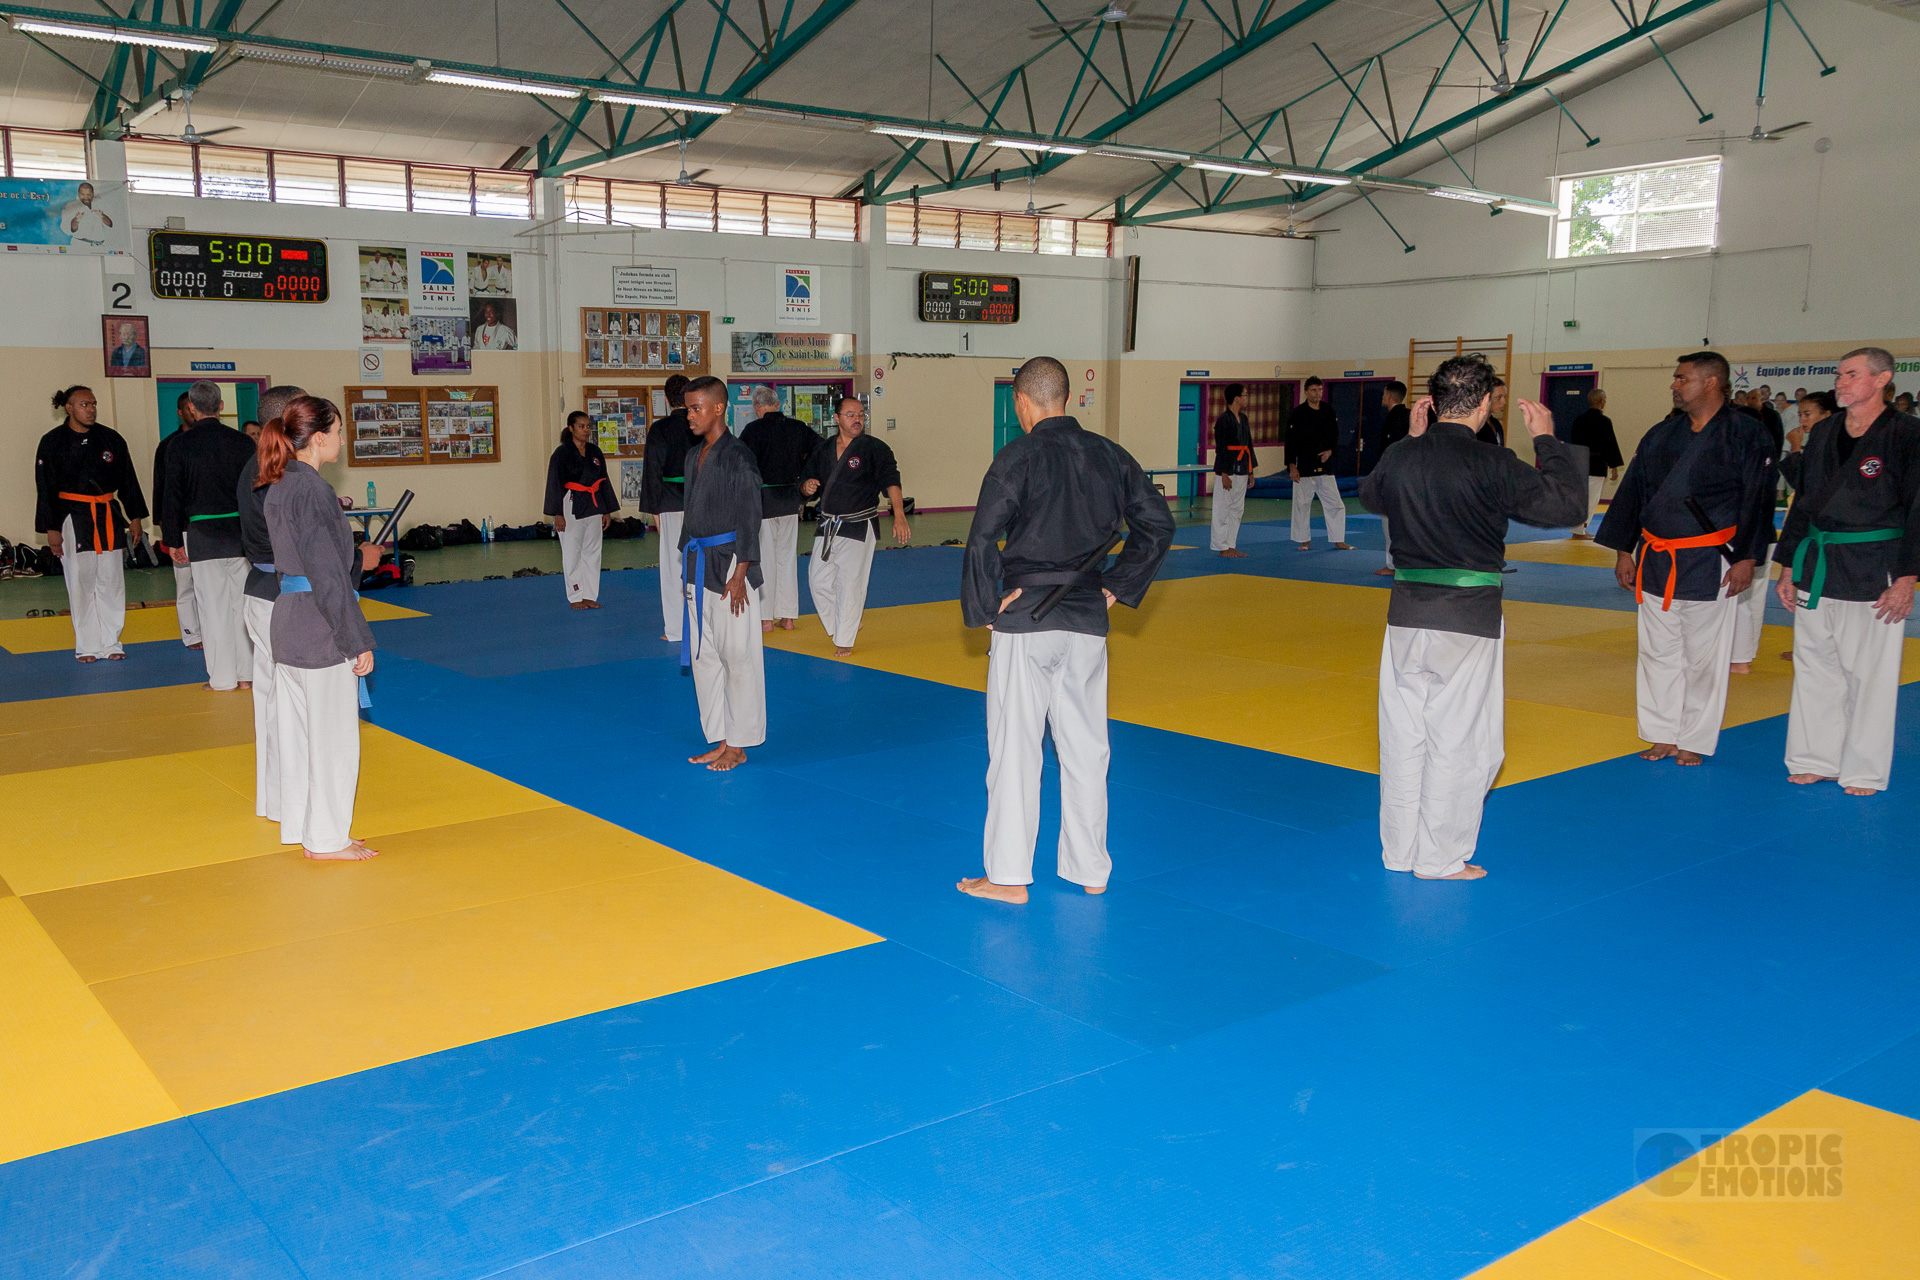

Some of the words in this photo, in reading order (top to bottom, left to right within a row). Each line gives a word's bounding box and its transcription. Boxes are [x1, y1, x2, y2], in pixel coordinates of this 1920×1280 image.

[209, 240, 272, 265] 5:00
[223, 282, 233, 297] 0
[264, 283, 274, 298] 0
[953, 278, 989, 296] 5:00
[111, 282, 133, 310] 2
[959, 308, 966, 320] 0
[981, 309, 988, 320] 0
[760, 336, 782, 347] Judo
[784, 337, 805, 347] Club
[962, 332, 969, 351] 1
[776, 349, 787, 359] de
[1756, 365, 1791, 377] Équipe
[1792, 366, 1806, 376] de
[1808, 365, 1837, 375] Franc
[1895, 362, 1920, 373] 2016
